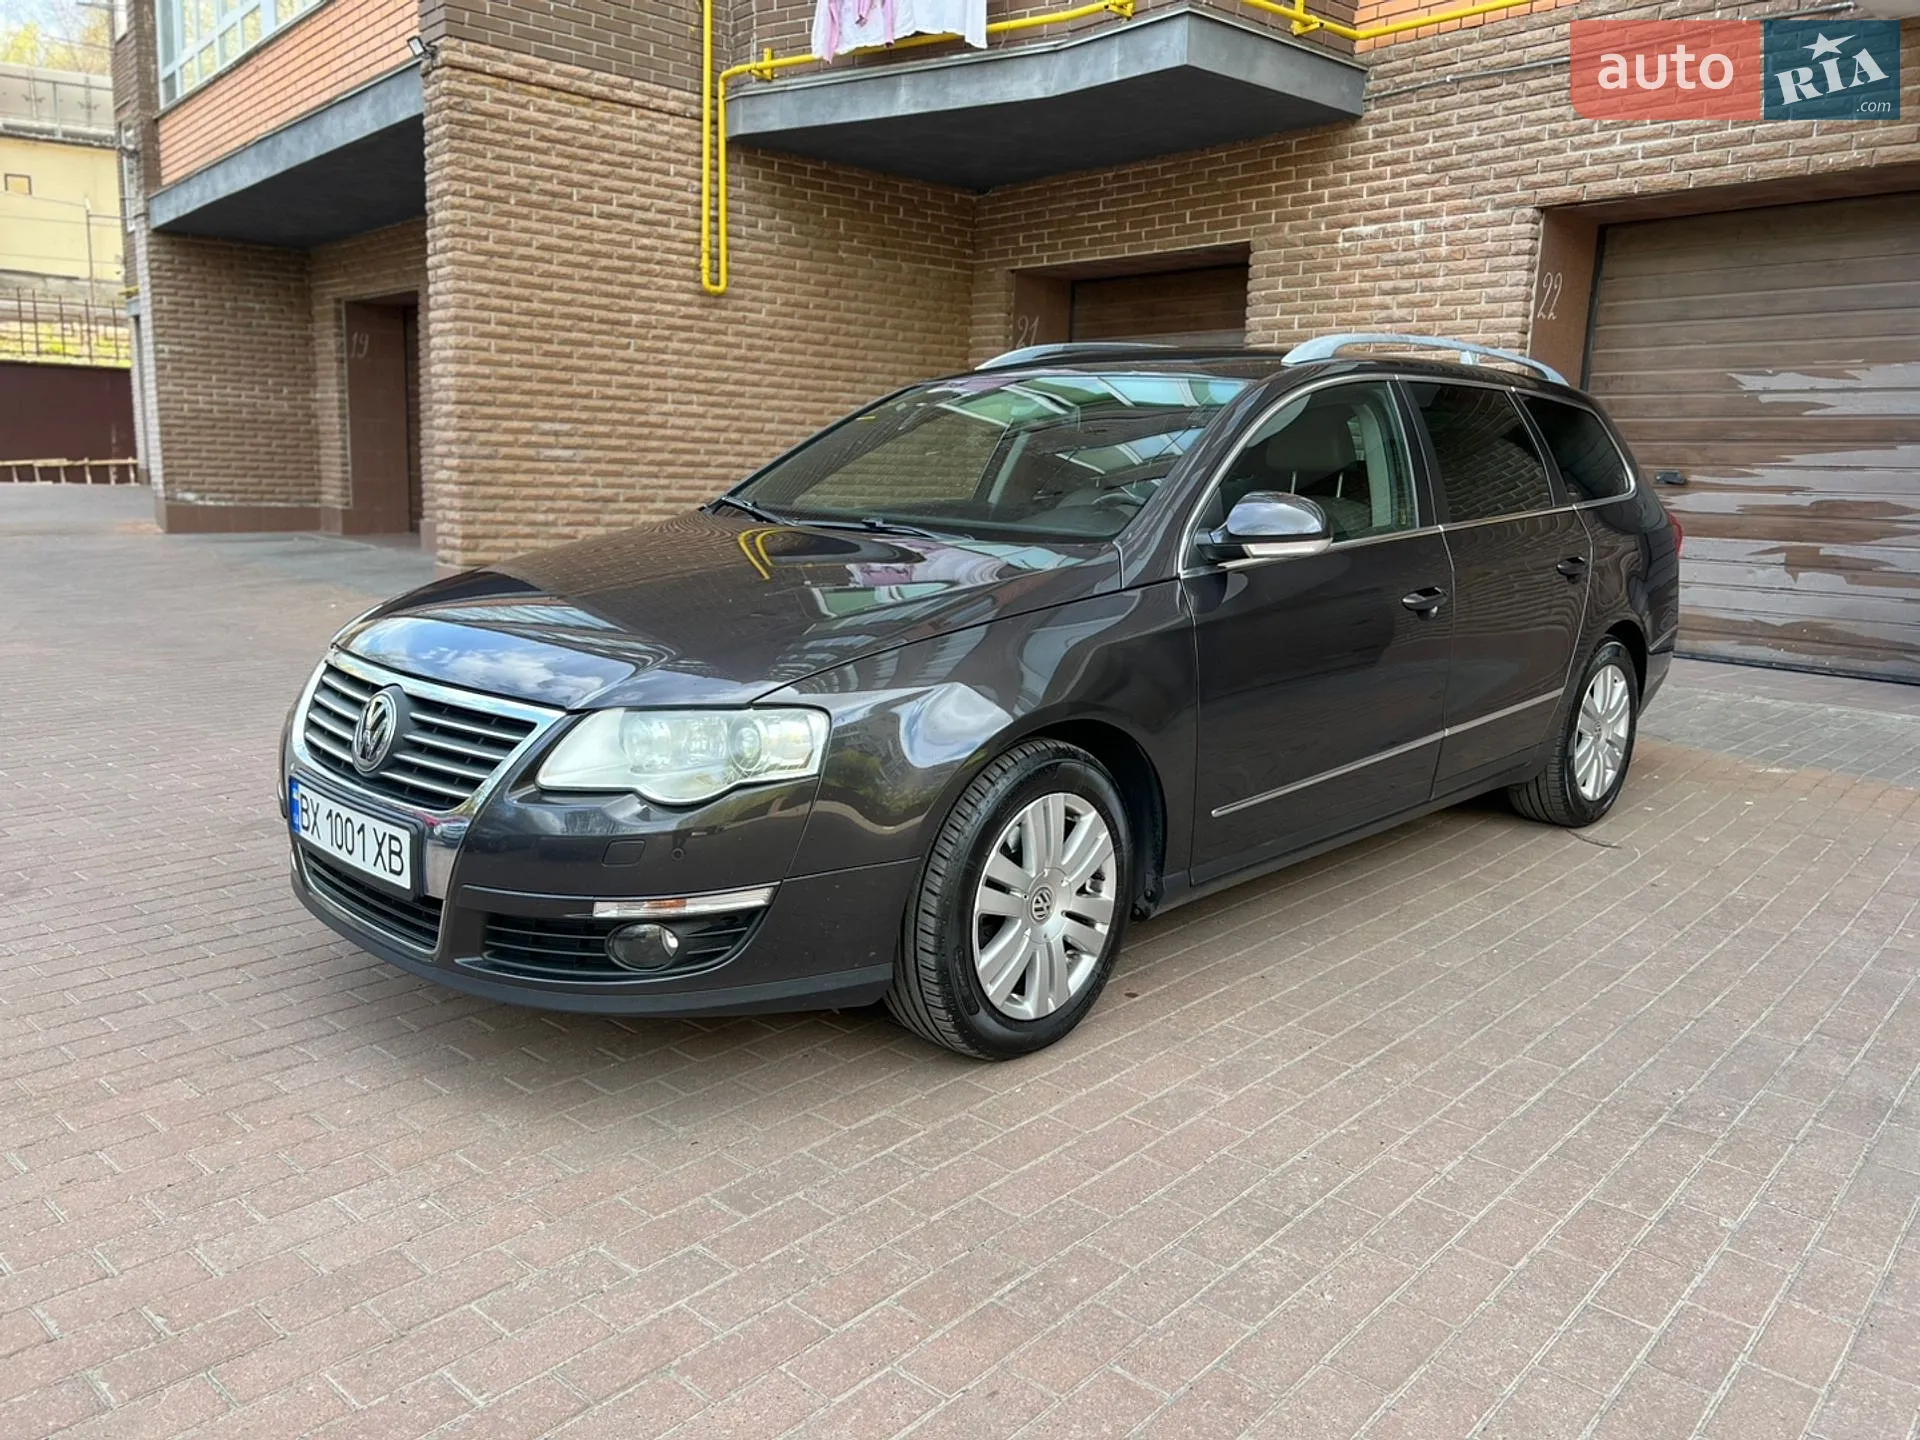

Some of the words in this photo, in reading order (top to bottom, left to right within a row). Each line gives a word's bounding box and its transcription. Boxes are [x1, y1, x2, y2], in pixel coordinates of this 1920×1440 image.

[1537, 271, 1563, 320] 22
[349, 331, 370, 359] 19
[1015, 314, 1040, 349] 21
[300, 793, 321, 841] BX
[326, 808, 366, 863] 1001
[372, 826, 404, 877] XB
